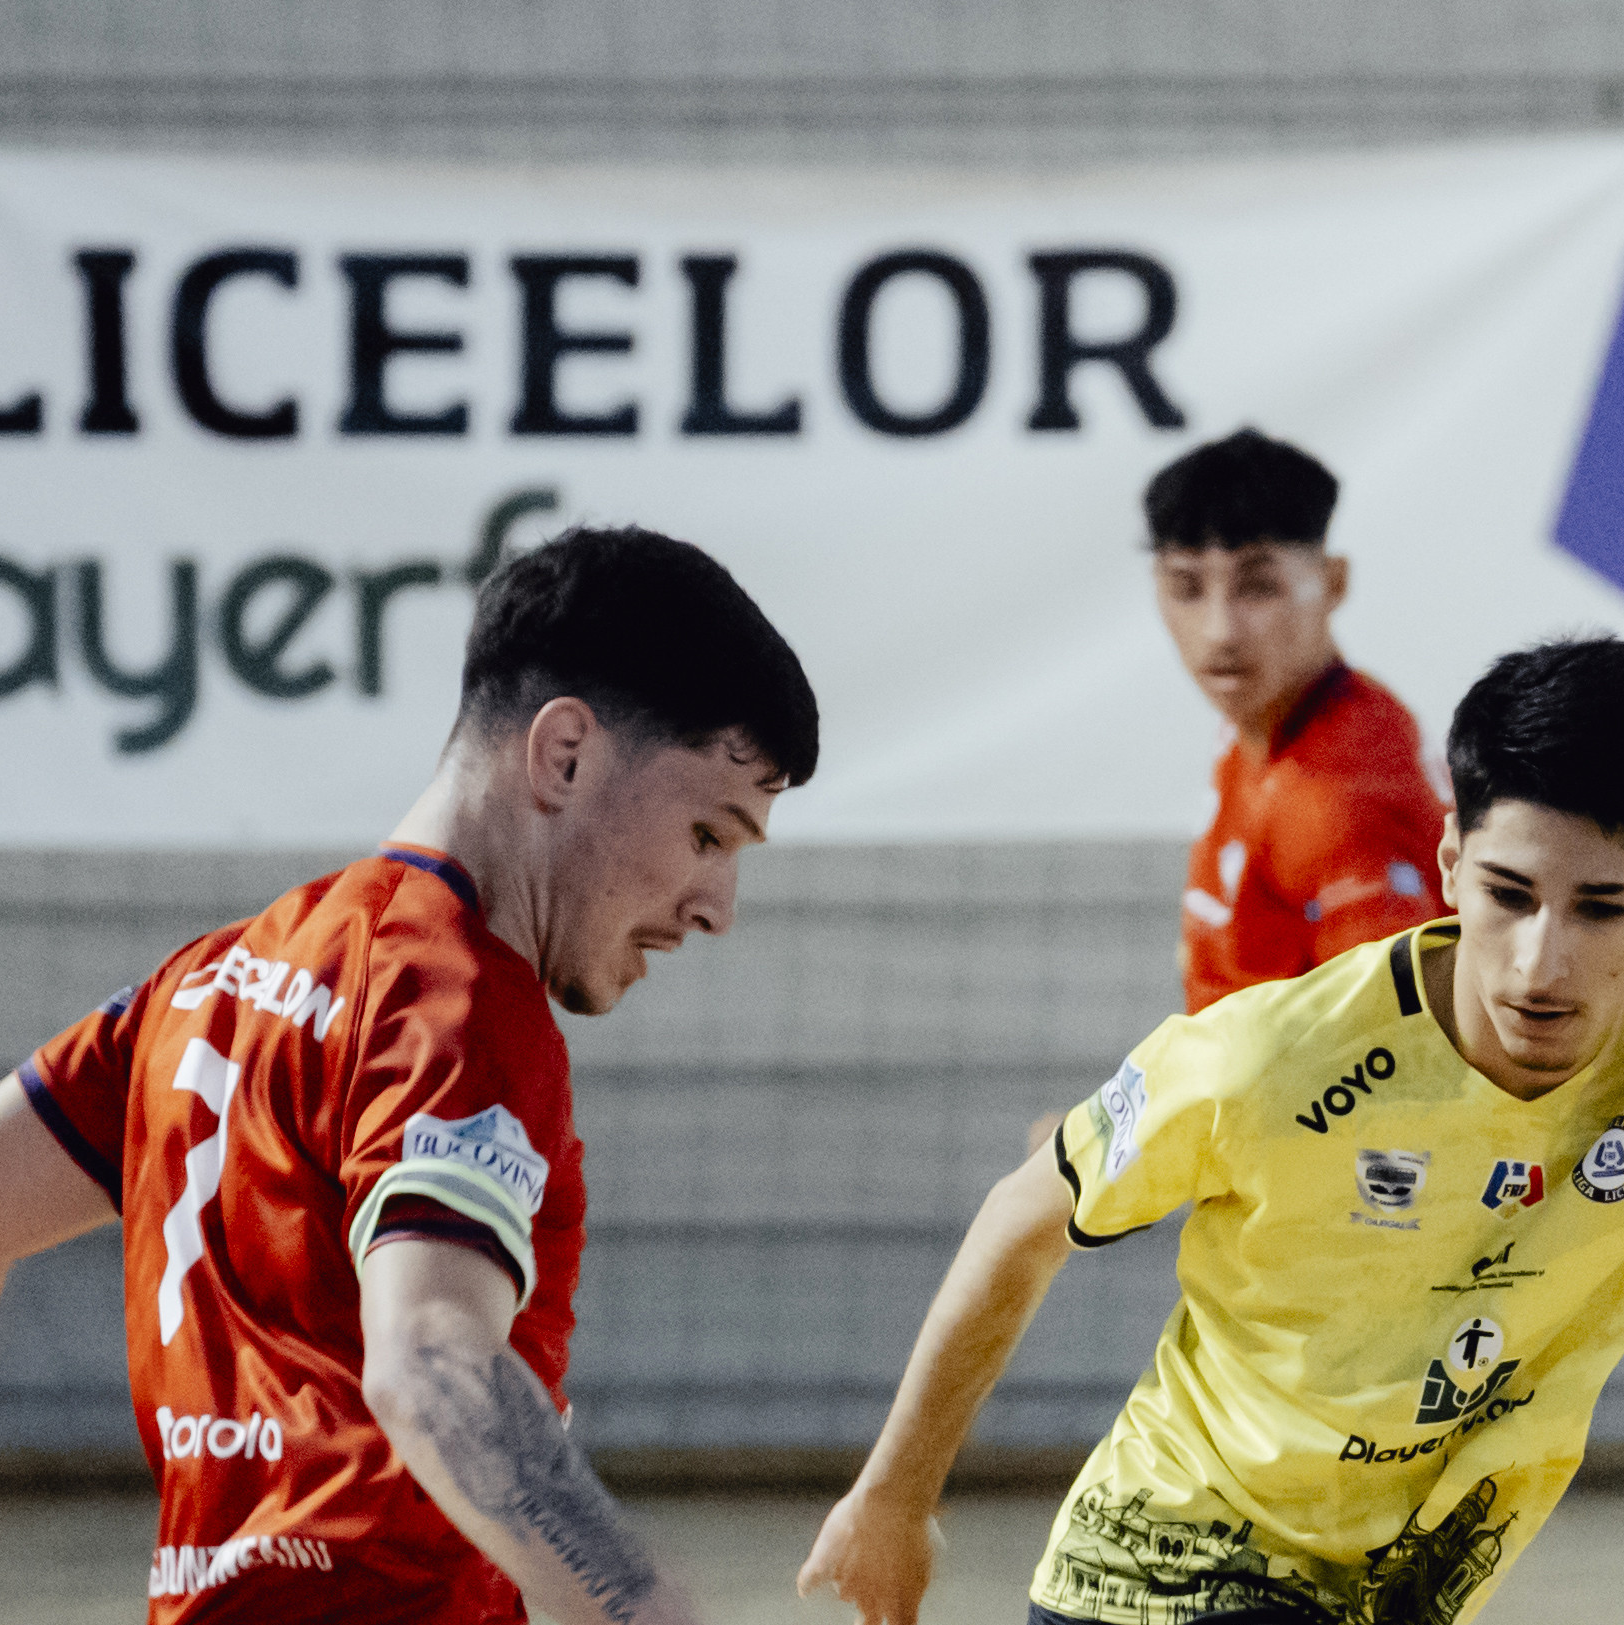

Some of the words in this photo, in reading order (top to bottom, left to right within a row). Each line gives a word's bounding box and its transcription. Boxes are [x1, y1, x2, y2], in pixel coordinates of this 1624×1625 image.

[1295, 1047, 1395, 1134] VOYO
[156, 1038, 241, 1347] 7
[1502, 1184, 1528, 1198] FRF
[156, 1405, 283, 1462] torola
